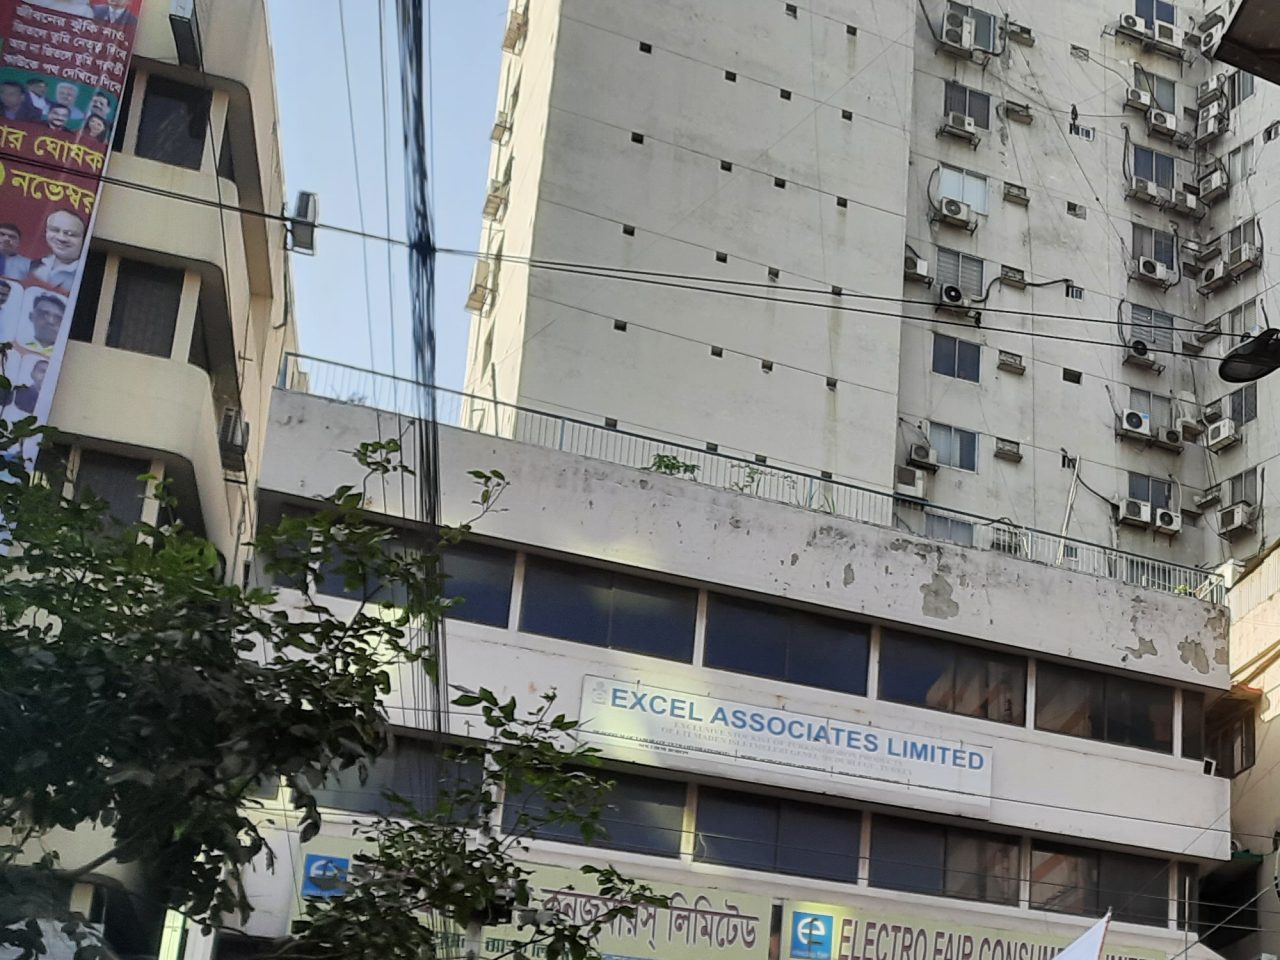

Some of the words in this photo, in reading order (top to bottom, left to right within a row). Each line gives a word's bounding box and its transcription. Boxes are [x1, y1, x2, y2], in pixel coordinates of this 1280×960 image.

[33, 136, 105, 173] ঘোষক
[10, 169, 97, 215] নভেম্বর
[611, 687, 703, 722] EXCEL
[709, 706, 879, 753] ASSOCIATES
[887, 738, 985, 771] LIMITED
[669, 892, 760, 949] লিমিটেড
